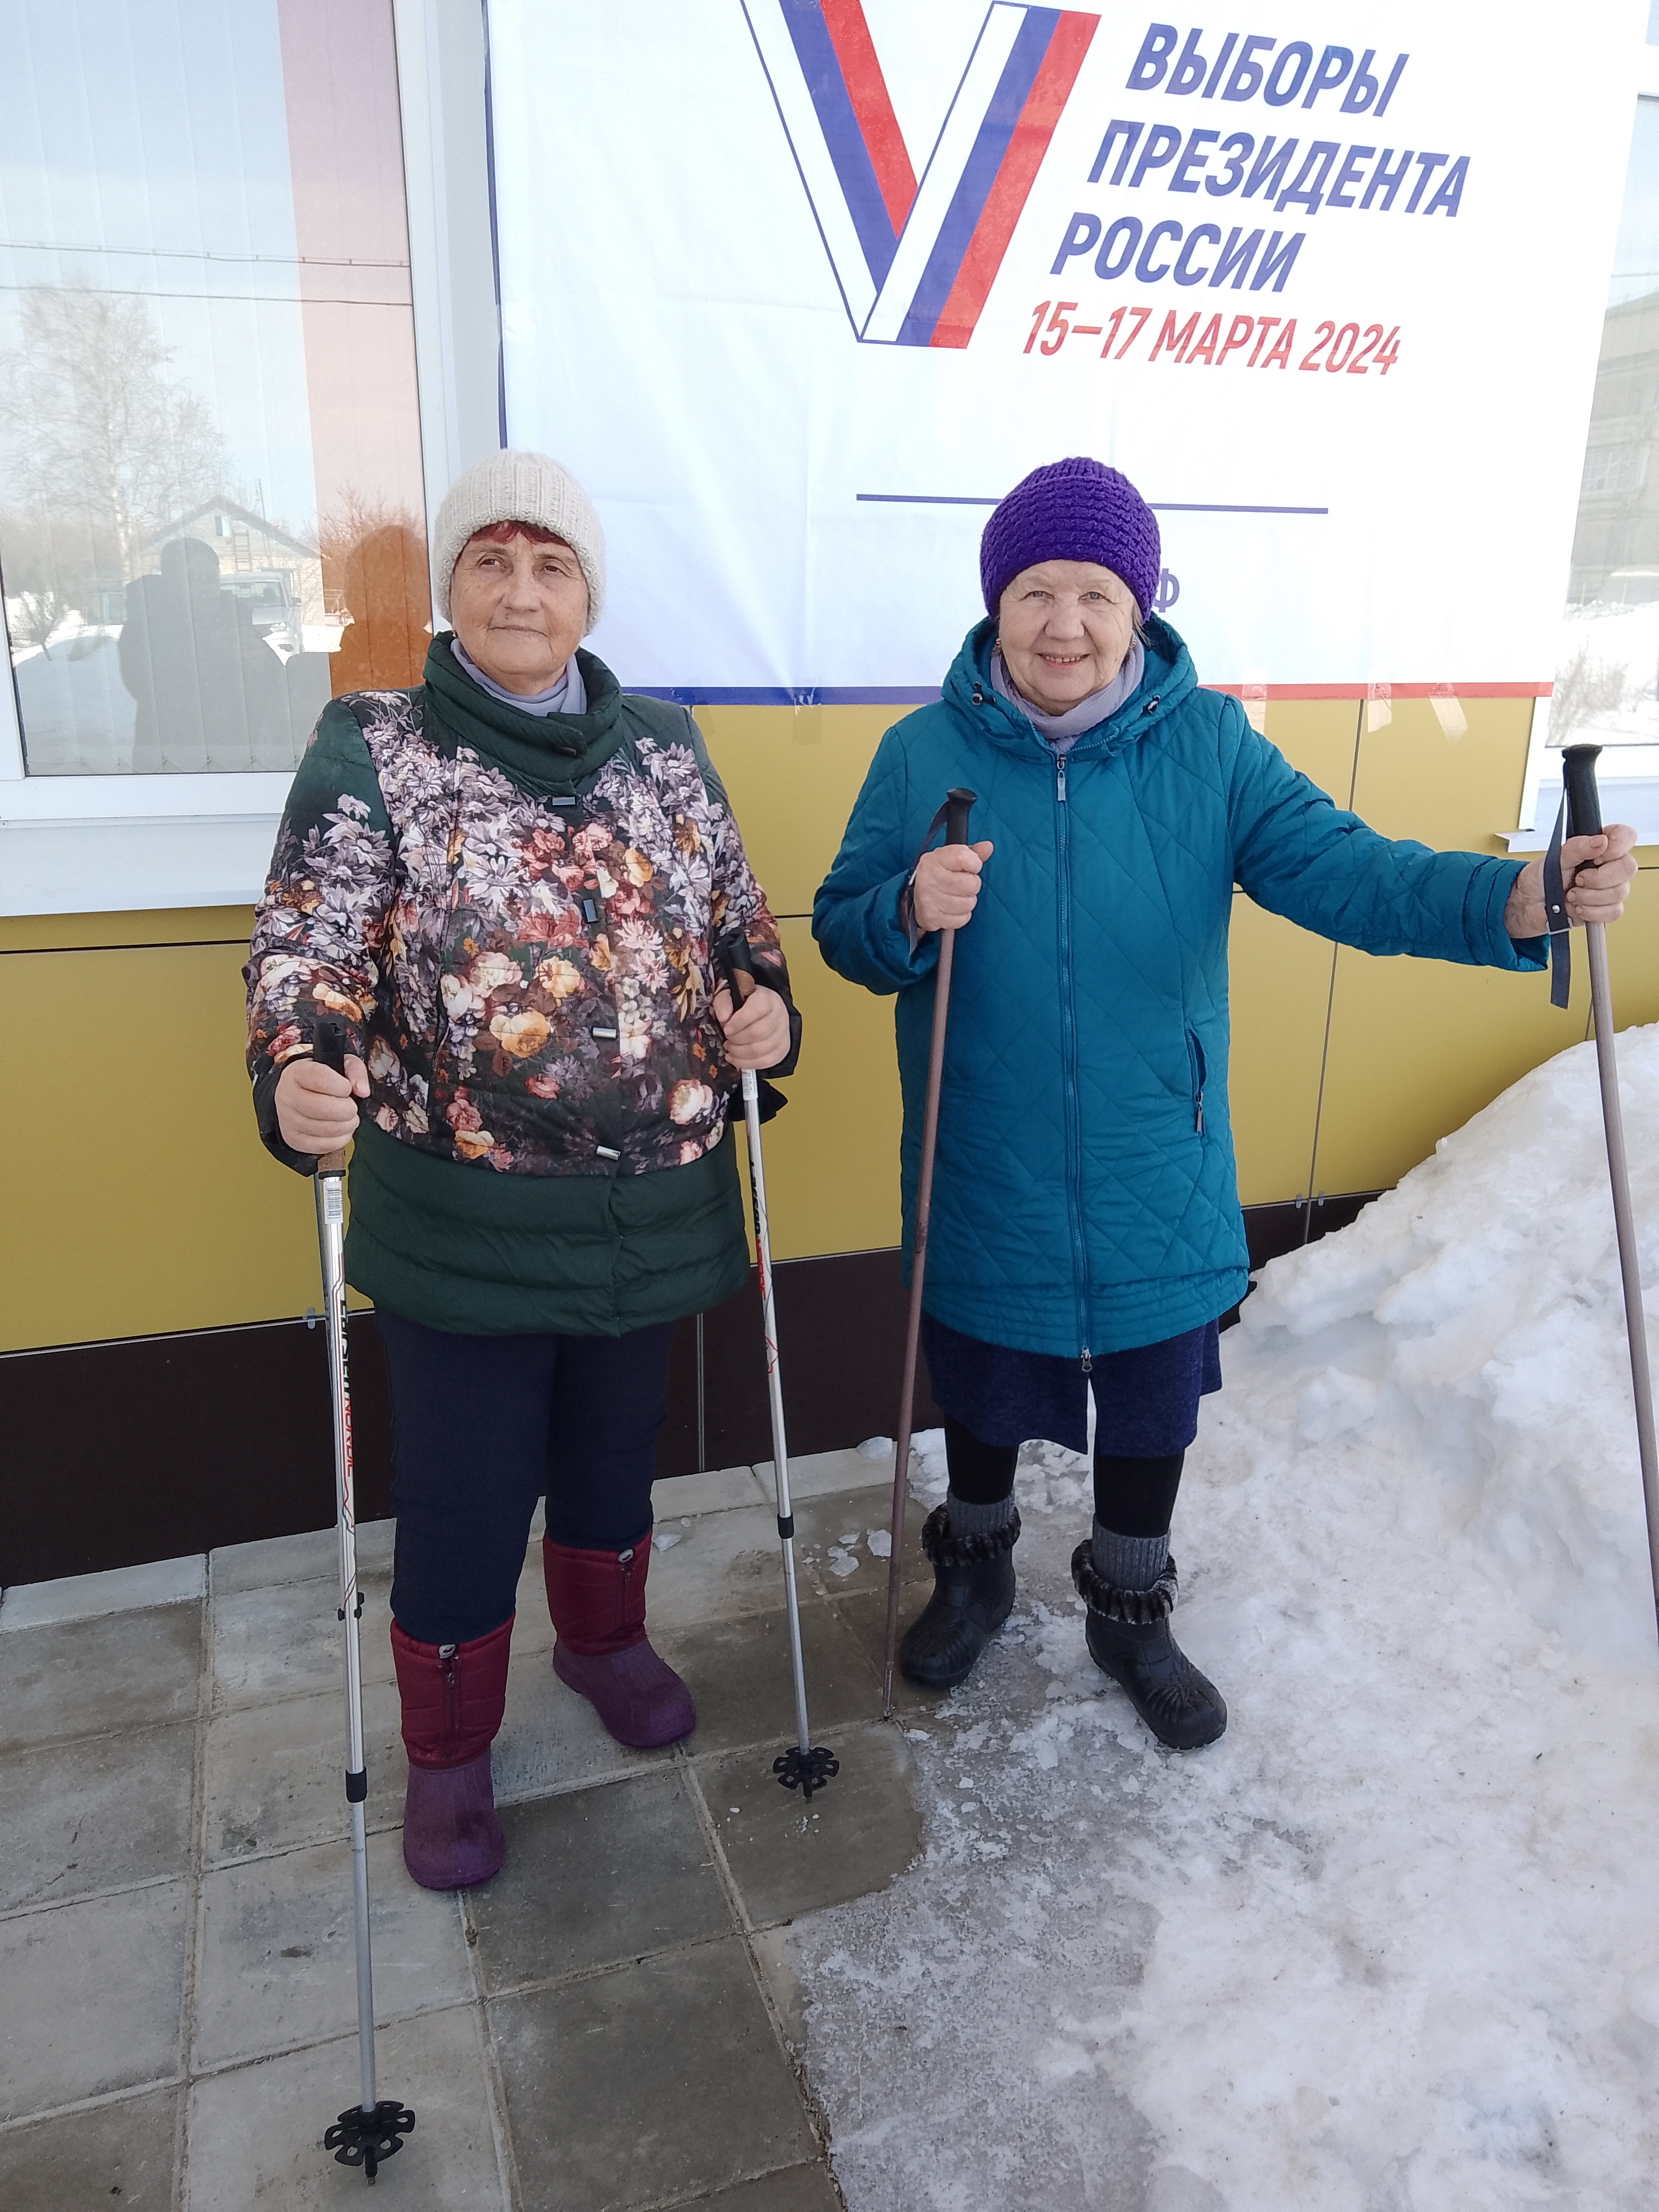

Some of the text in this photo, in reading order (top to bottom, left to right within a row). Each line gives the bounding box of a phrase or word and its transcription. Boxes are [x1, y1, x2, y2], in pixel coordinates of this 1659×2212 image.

[1125, 23, 1409, 117] ВЫБОРЫ
[1087, 120, 1470, 217] ПРЕЗИДЕНТА
[1050, 212, 1306, 292] РОССИИ
[1149, 310, 1297, 370] МАРТА
[1298, 321, 1401, 375] 2024
